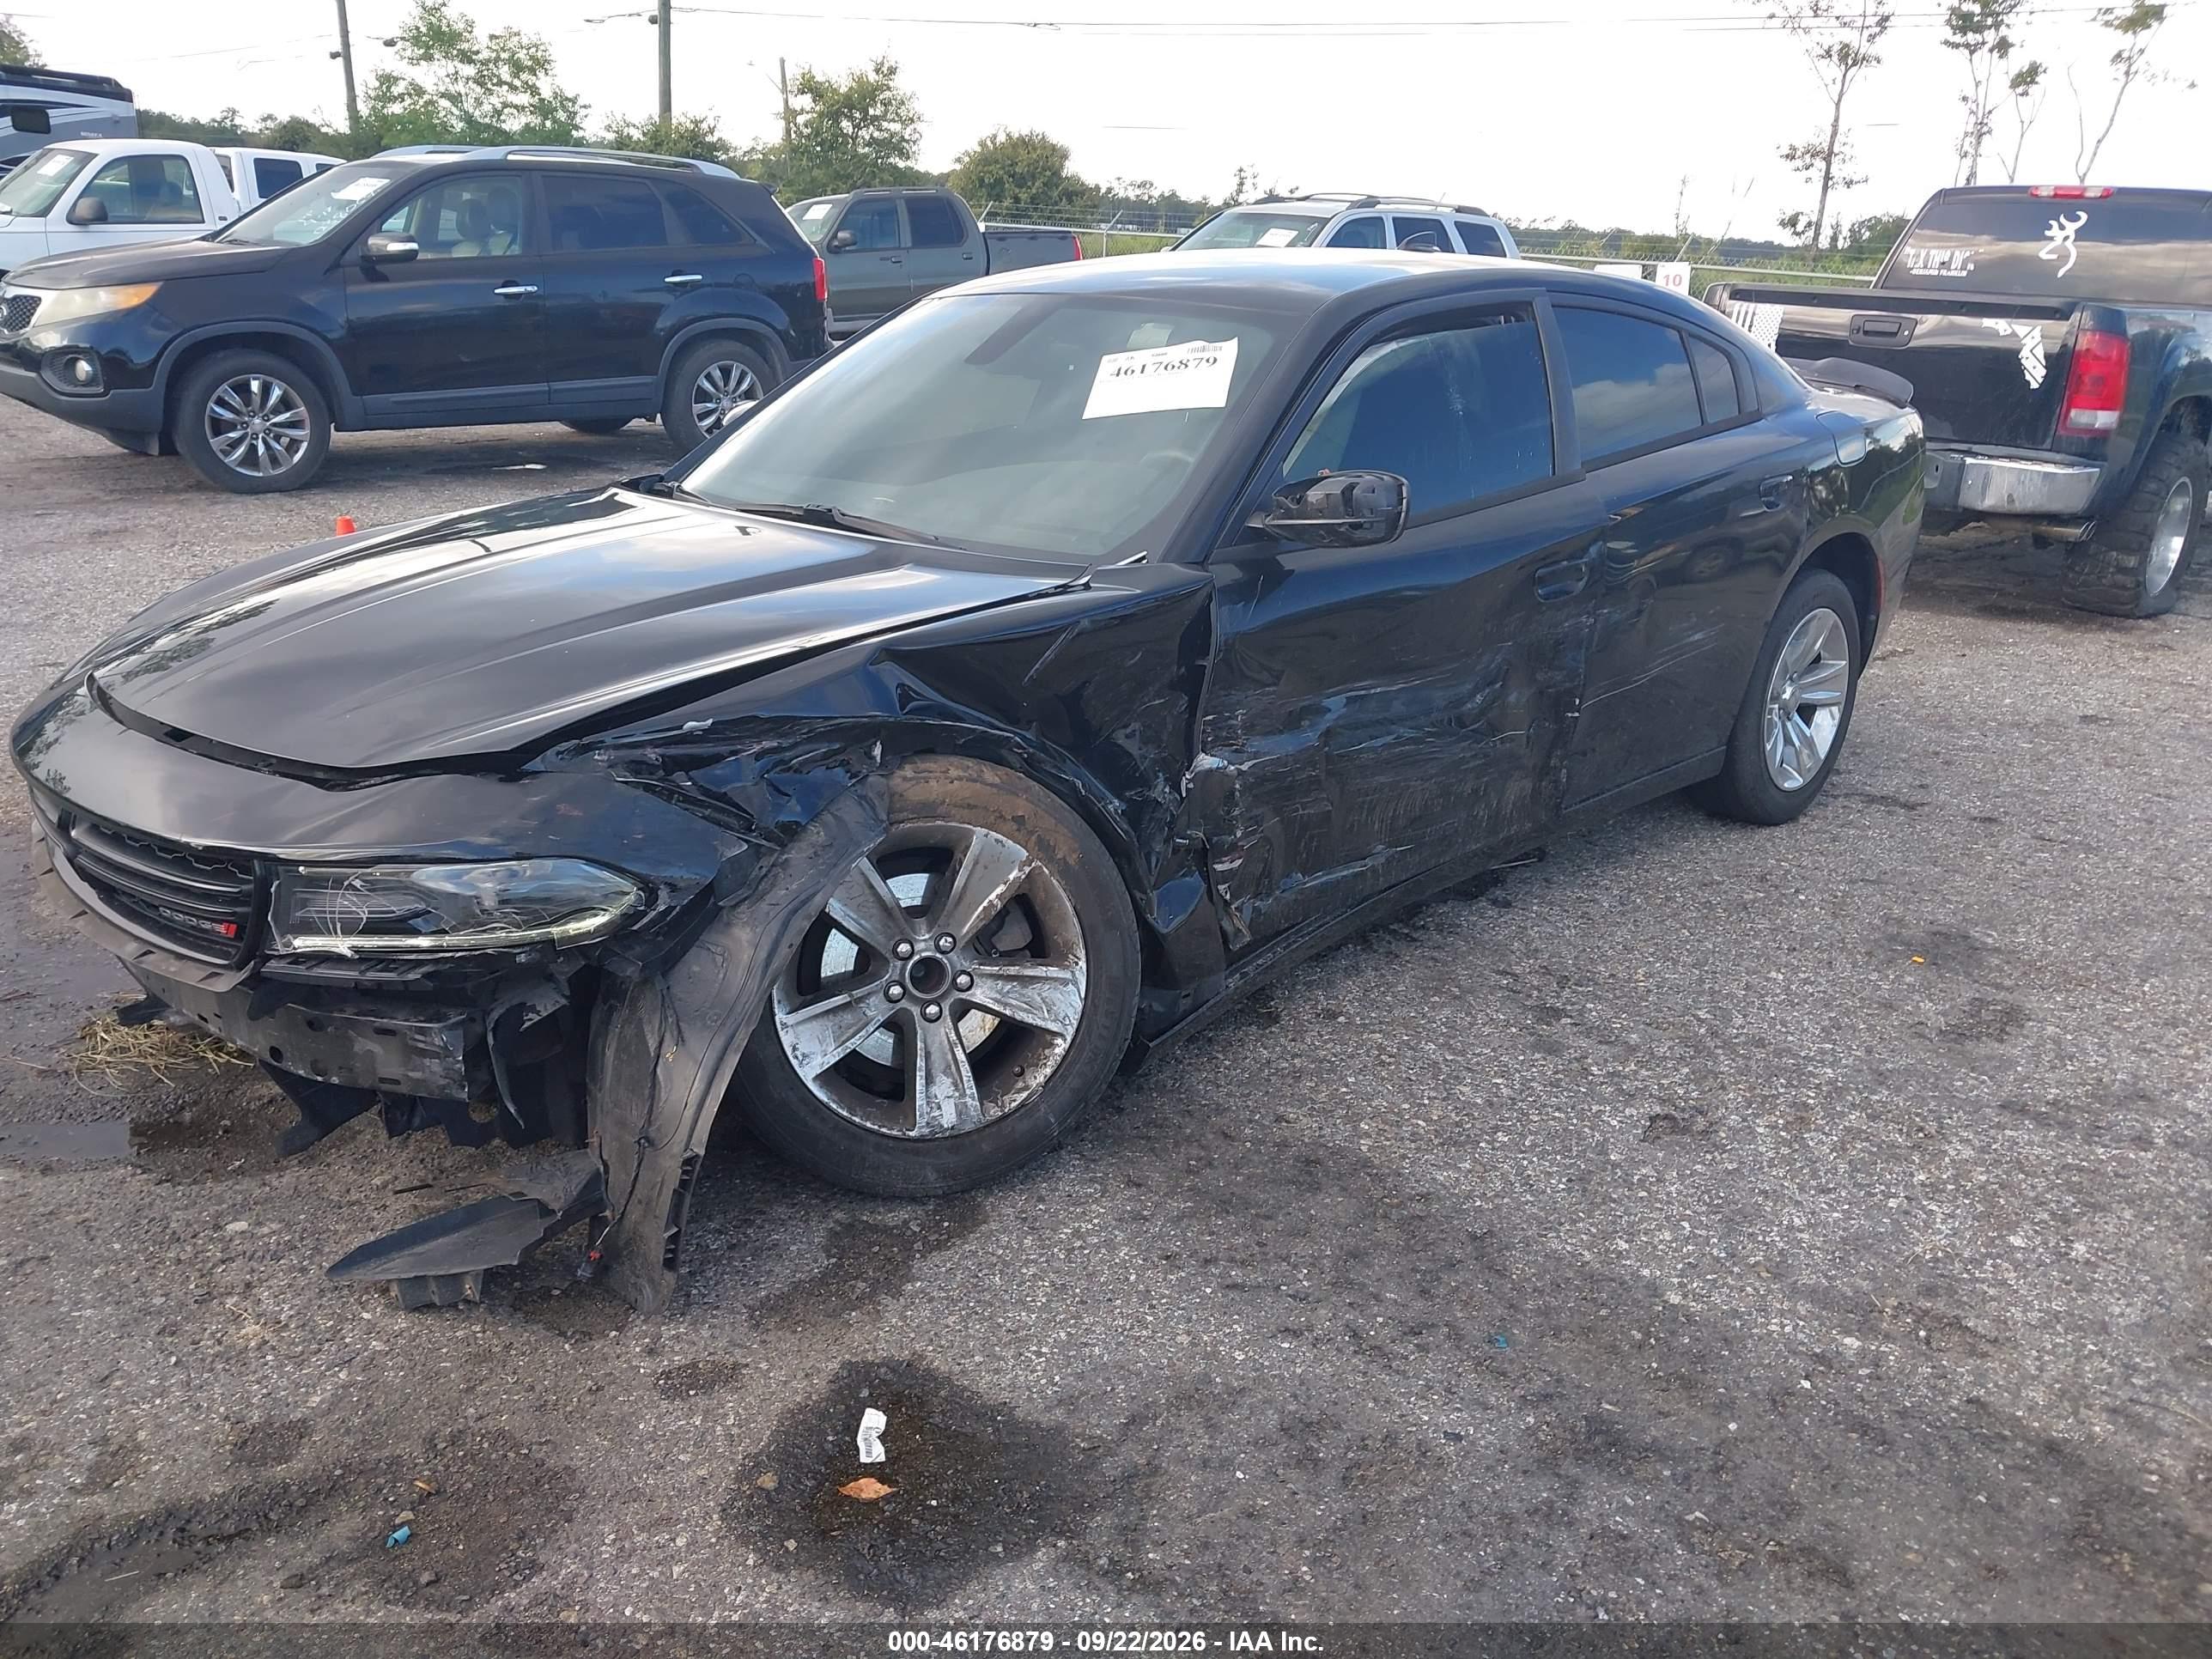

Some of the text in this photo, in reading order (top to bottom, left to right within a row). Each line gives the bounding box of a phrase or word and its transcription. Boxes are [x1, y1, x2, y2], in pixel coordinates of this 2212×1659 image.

[1663, 274, 1683, 287] 10
[1109, 356, 1218, 378] 46176879
[159, 907, 228, 933] DODGE
